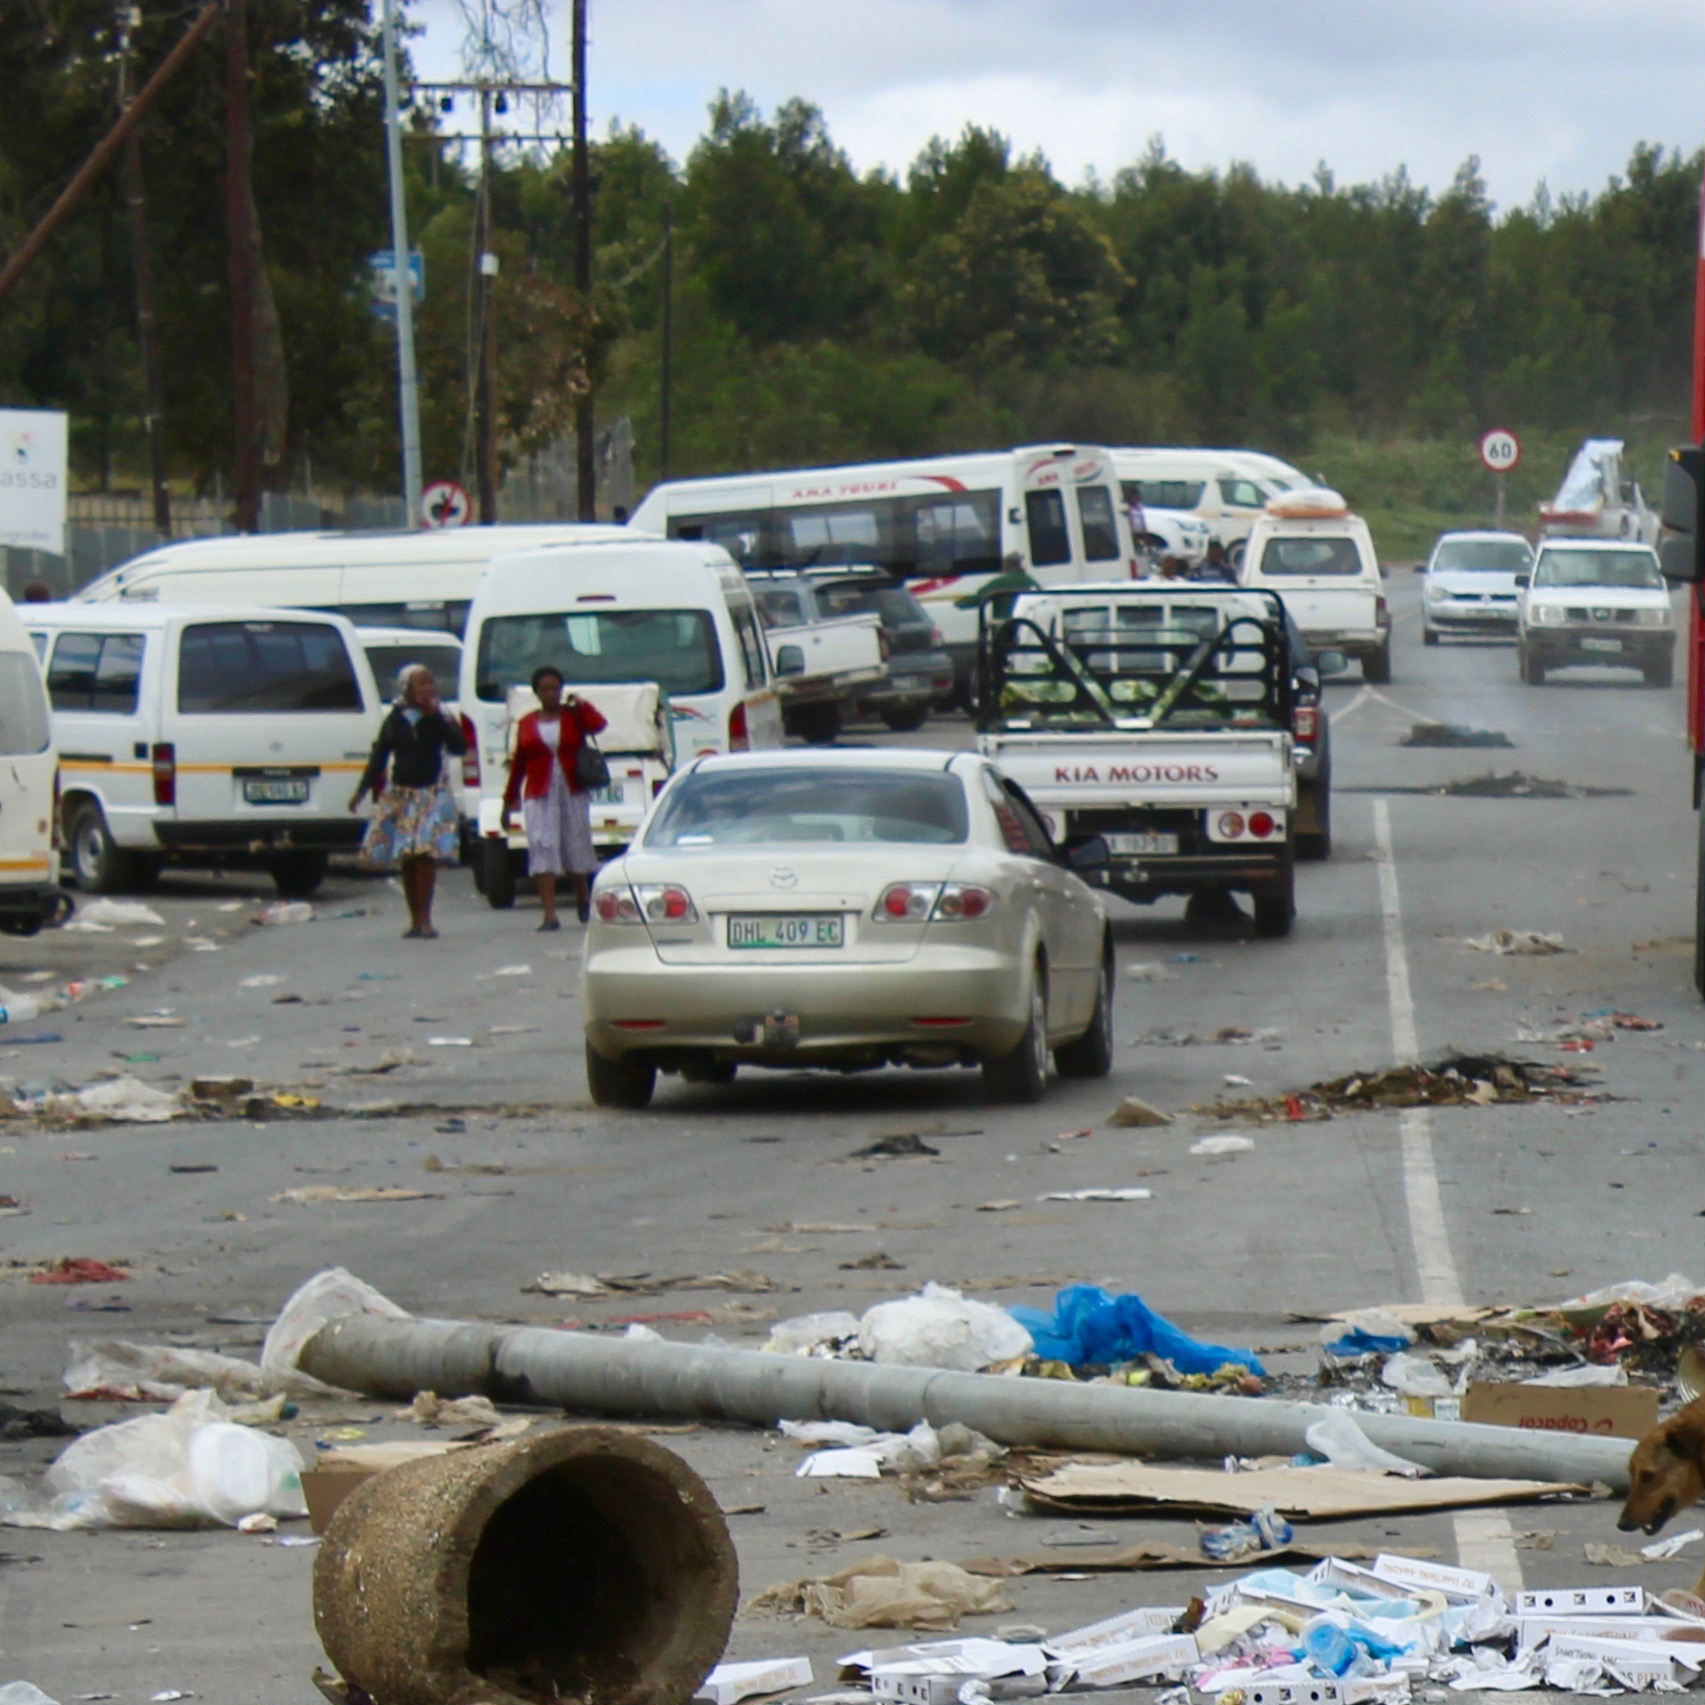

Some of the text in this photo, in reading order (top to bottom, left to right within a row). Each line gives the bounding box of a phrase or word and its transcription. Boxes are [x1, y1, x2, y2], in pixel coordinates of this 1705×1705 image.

[1489, 442, 1511, 460] 60
[1055, 765, 1219, 783] KIA MOTORS
[733, 920, 839, 943] DHL 409 EC
